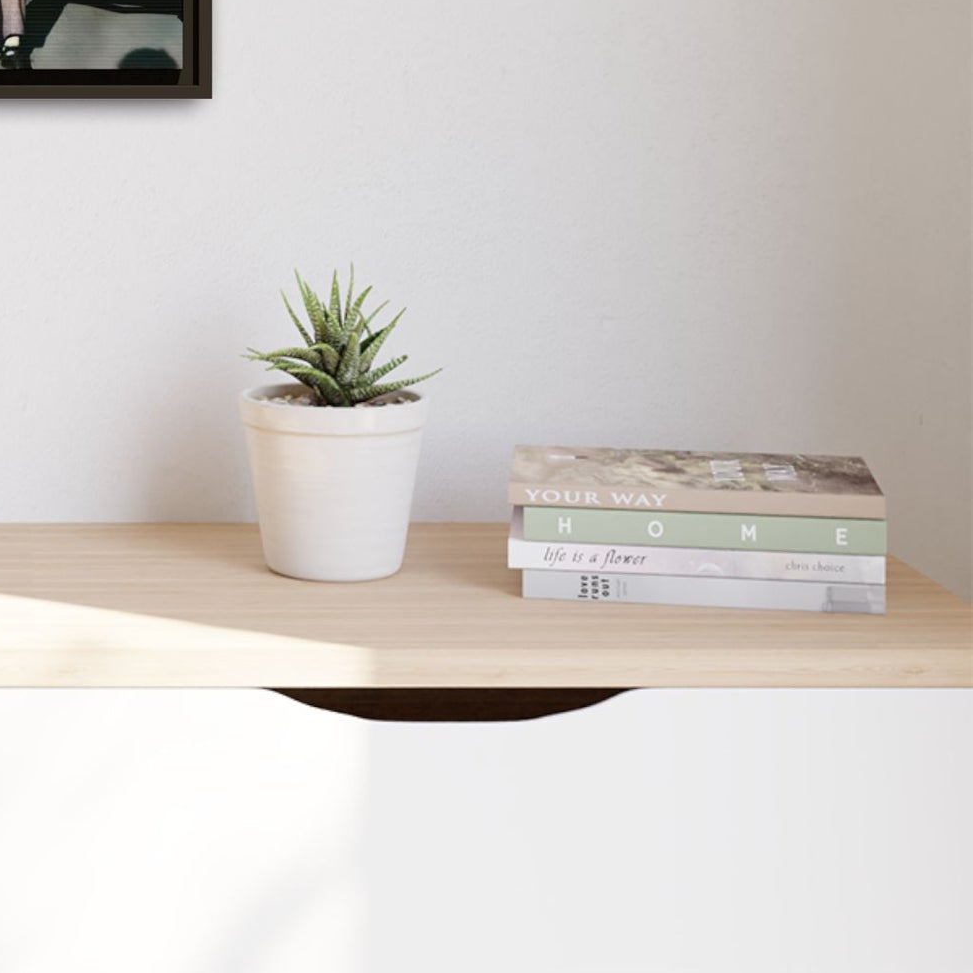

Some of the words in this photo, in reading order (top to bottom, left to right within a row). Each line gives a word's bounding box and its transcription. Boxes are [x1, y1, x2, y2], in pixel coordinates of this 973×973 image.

[525, 489, 601, 505] YOUR
[611, 492, 667, 507] WAY
[543, 546, 566, 567] life
[572, 549, 583, 563] is
[589, 553, 597, 564] a
[600, 549, 647, 569] flower
[785, 559, 809, 571] chris
[812, 560, 845, 573] choice
[577, 575, 588, 598] love
[591, 575, 599, 600] runs
[600, 578, 610, 597] out
